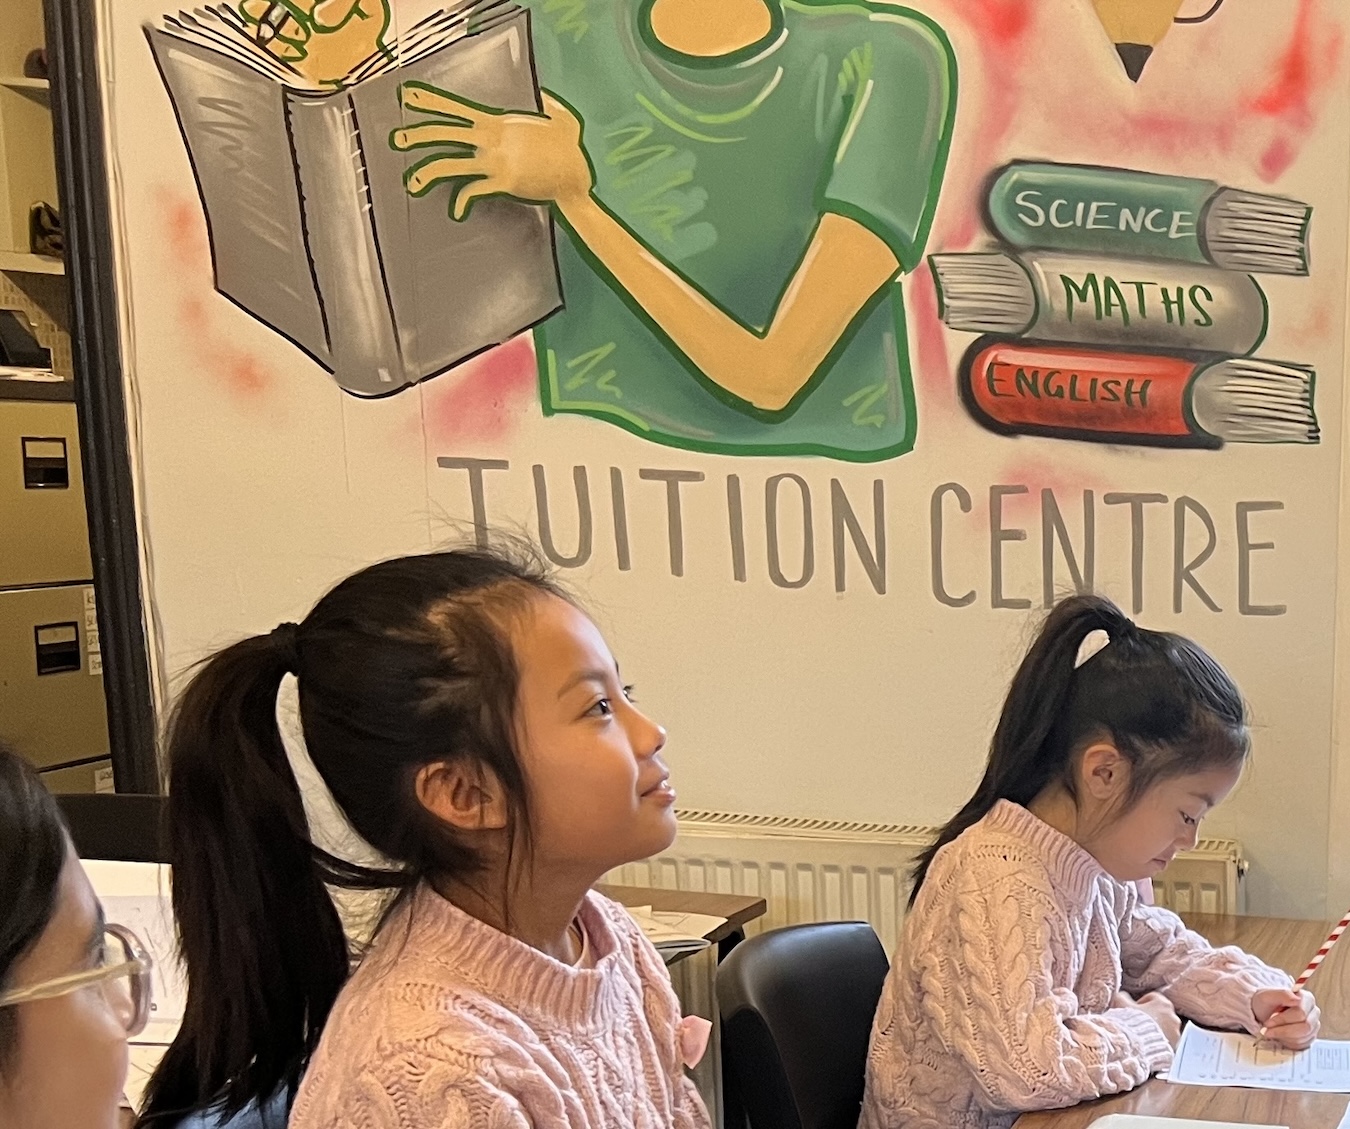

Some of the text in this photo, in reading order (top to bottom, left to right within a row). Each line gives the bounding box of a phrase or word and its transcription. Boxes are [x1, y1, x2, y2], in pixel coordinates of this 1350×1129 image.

[1014, 190, 1197, 239] SCIENCE
[1059, 272, 1213, 327] MATHS
[986, 361, 1153, 407] ENGLISH
[437, 456, 1287, 616] TUITION CENTRE
